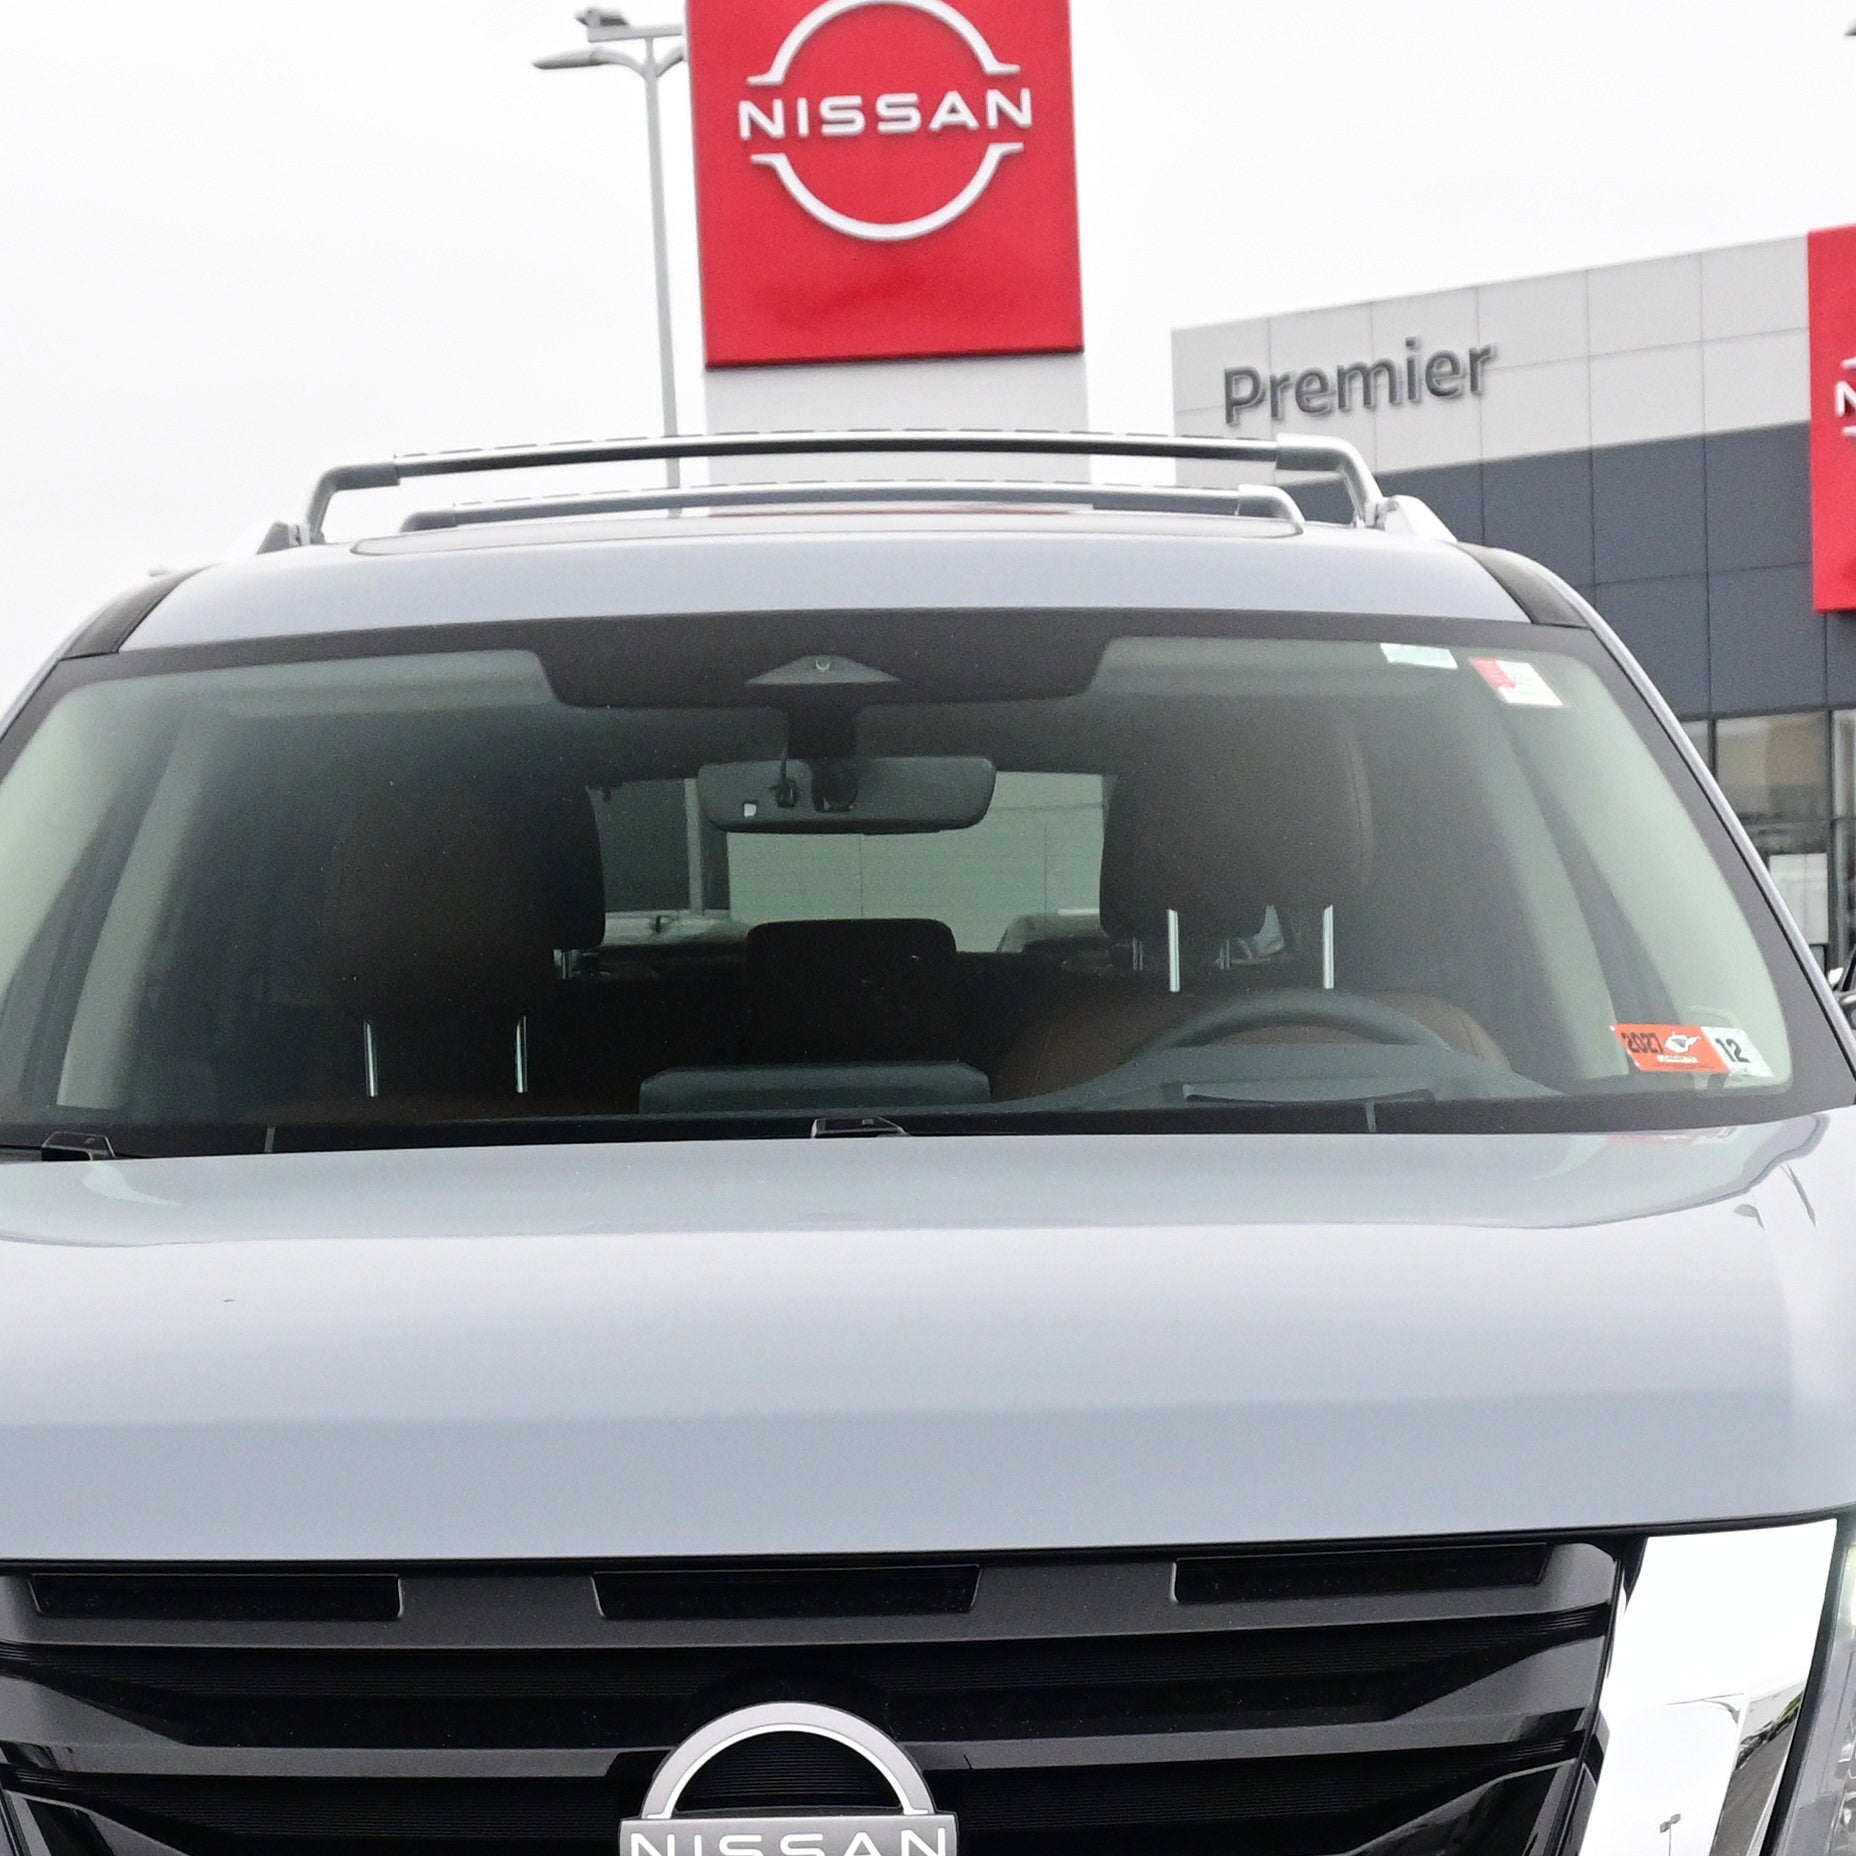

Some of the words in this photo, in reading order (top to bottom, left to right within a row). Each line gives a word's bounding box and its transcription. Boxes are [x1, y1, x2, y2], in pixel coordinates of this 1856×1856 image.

[738, 88, 1032, 140] NISSAN
[1223, 336, 1495, 425] Premier
[1621, 1032, 1664, 1054] 2027
[1715, 1037, 1751, 1063] 12
